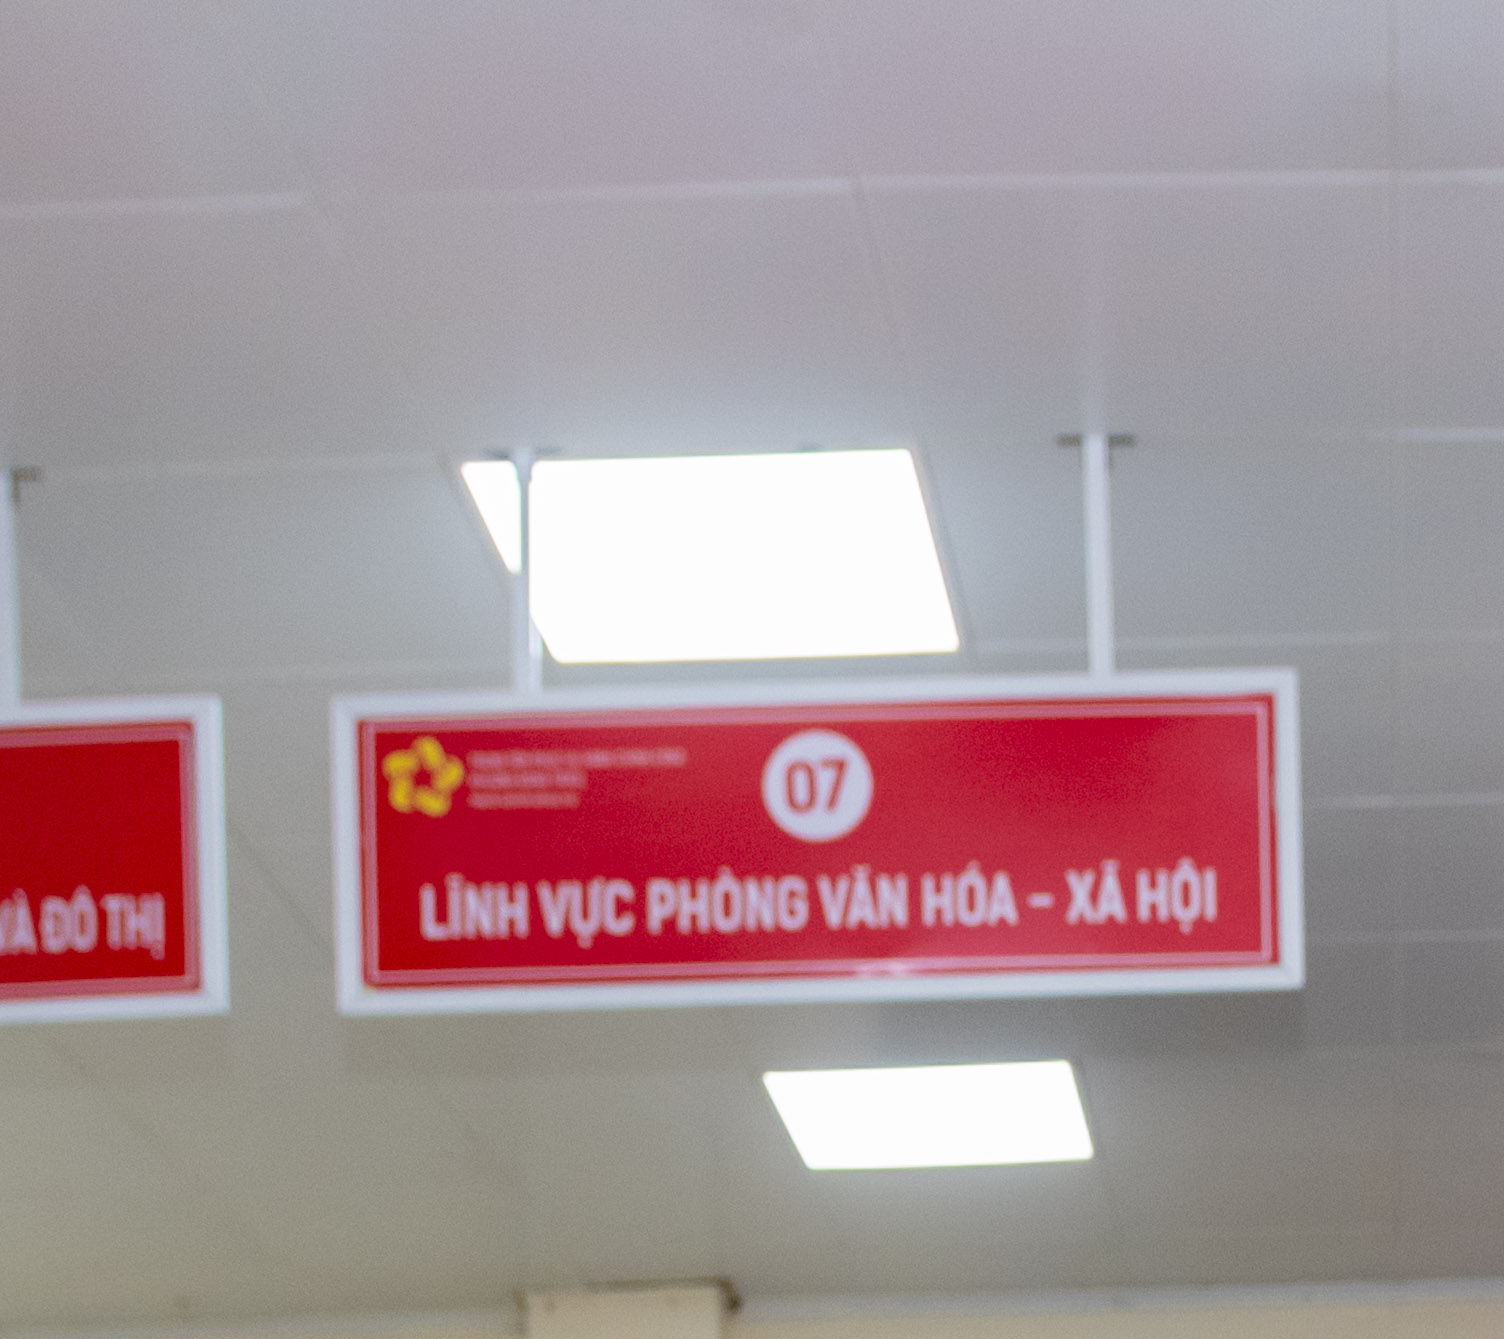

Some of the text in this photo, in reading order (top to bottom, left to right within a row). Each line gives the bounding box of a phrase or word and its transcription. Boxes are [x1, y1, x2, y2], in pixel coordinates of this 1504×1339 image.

[784, 758, 849, 815] 07
[100, 891, 166, 960] THỊ
[419, 872, 527, 941] LĨNH
[538, 874, 635, 949] VỰC
[647, 865, 809, 935] PHÒNG
[819, 860, 908, 930] VĂN
[921, 860, 1020, 930] HÓA
[1065, 857, 1128, 924] XÃ
[1136, 856, 1218, 935] HỘI
